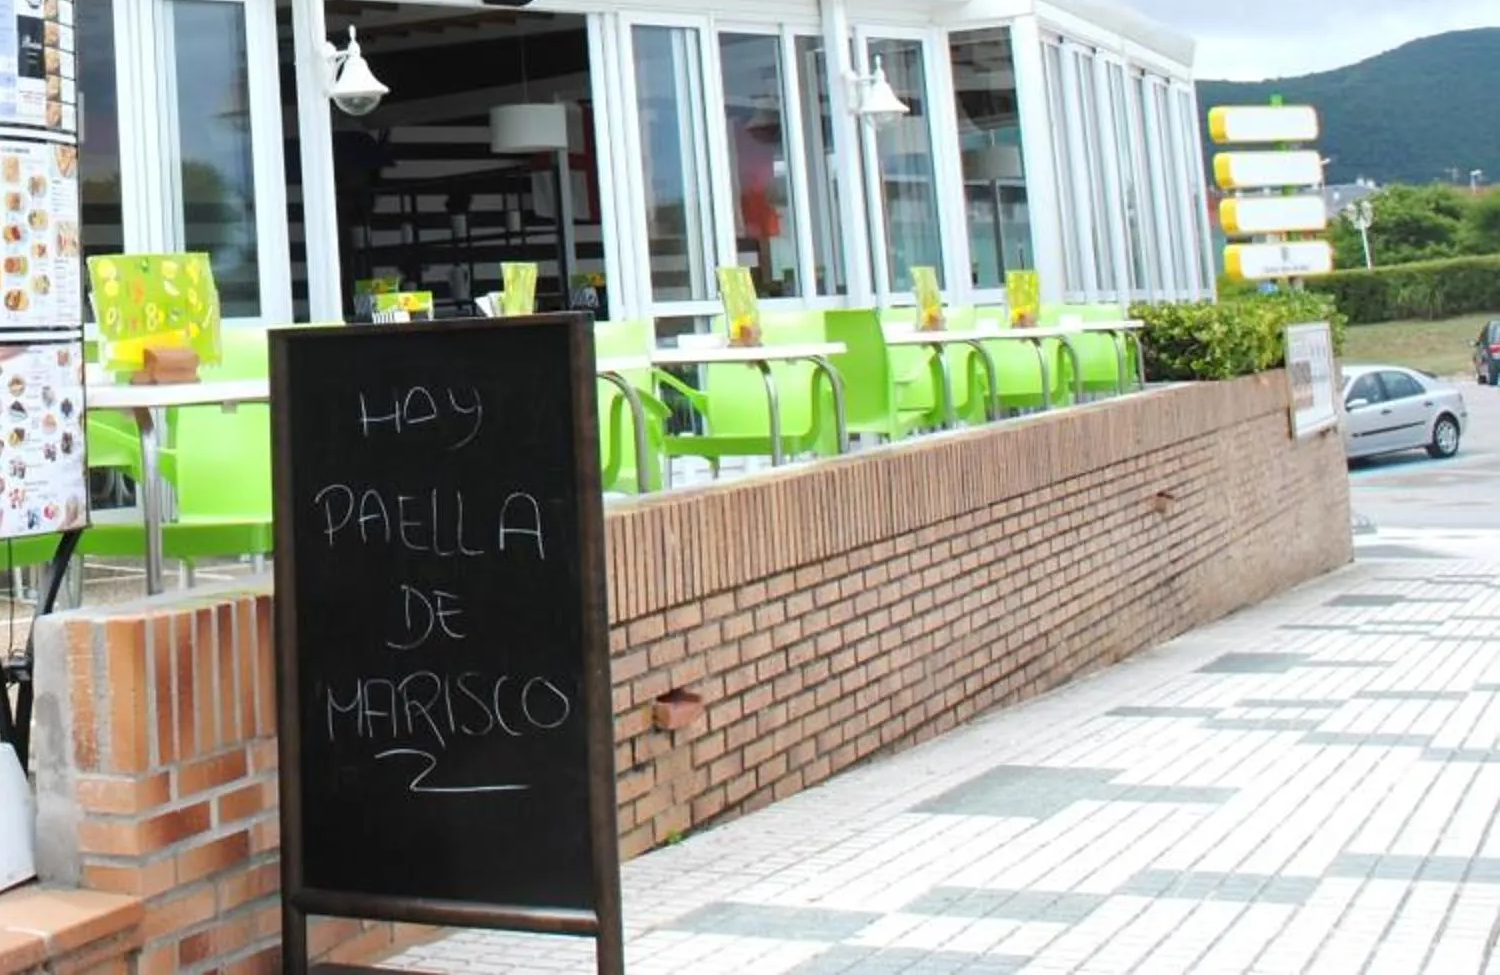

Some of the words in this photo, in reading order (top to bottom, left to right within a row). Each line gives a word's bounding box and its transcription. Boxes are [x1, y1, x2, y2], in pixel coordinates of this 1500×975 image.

[359, 386, 483, 449] HAY
[314, 483, 546, 561] PAELLA
[386, 583, 466, 650] DE
[326, 670, 570, 748] MARISCO
